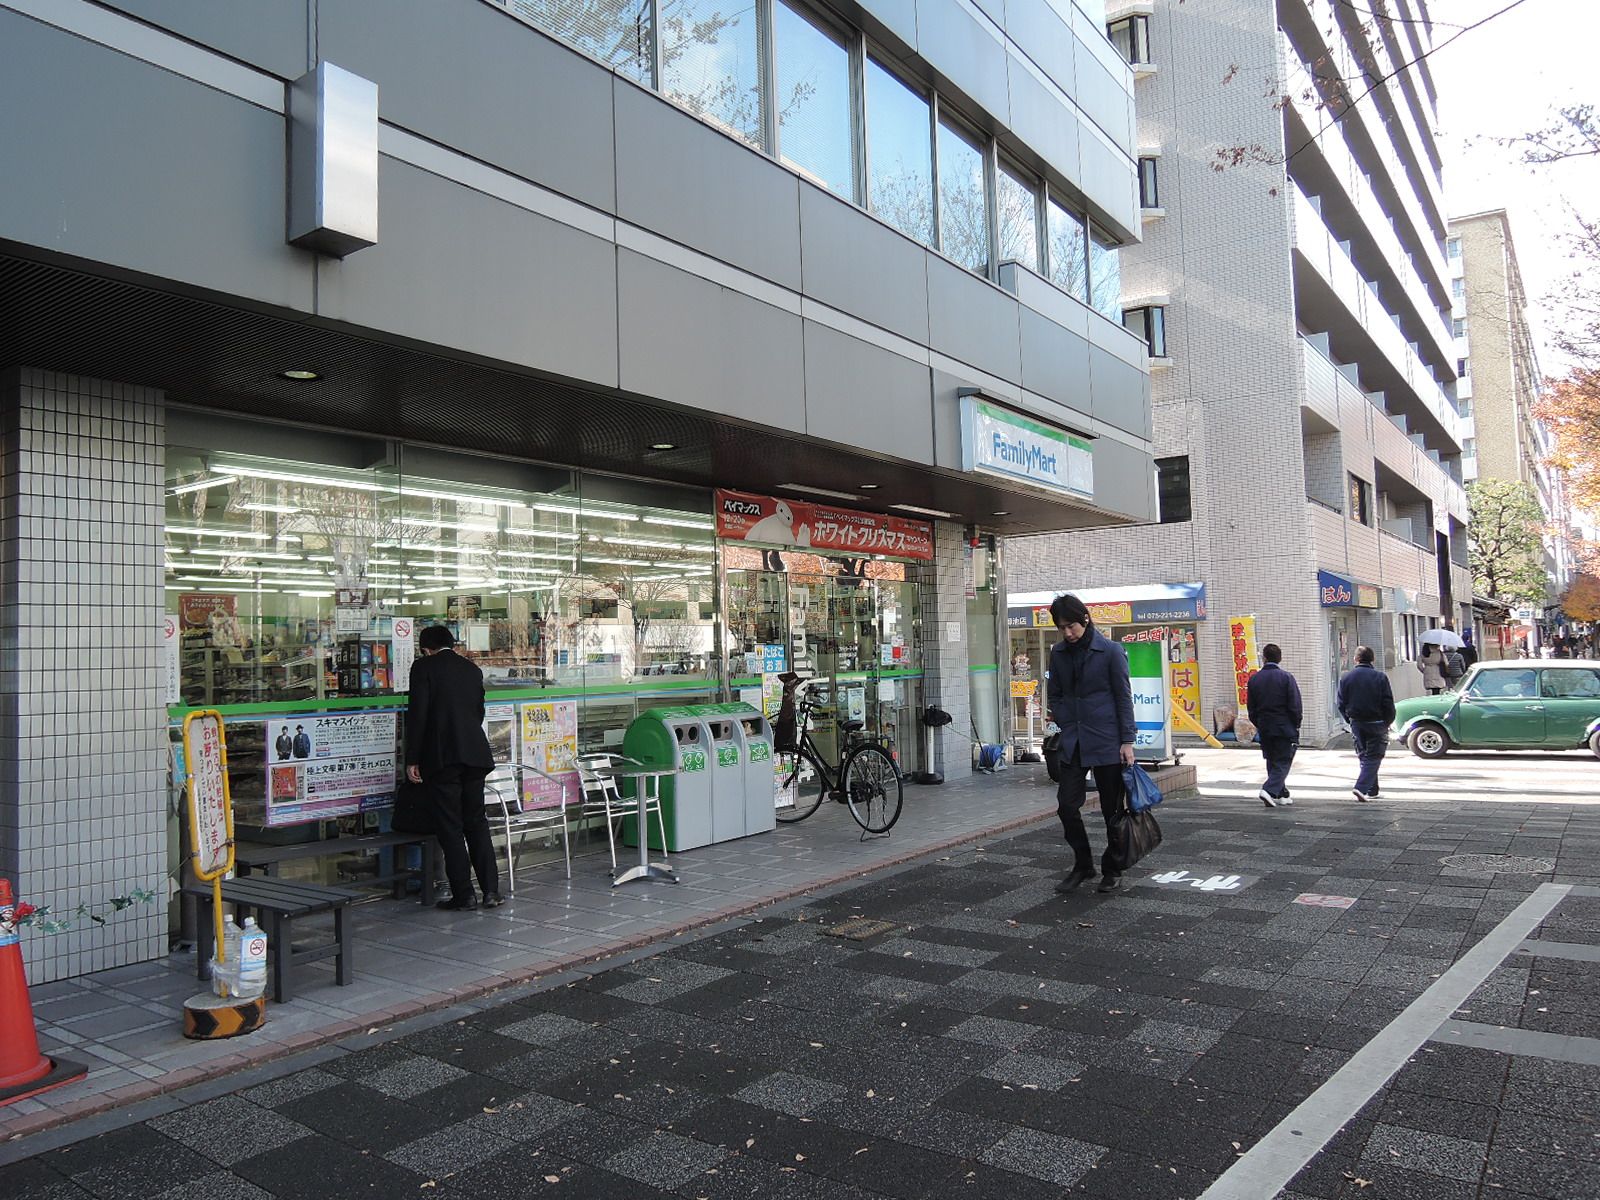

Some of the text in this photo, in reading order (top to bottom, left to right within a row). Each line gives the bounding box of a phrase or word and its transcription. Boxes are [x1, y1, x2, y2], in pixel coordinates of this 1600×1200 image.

[992, 432, 1057, 474] FamilyMart
[813, 520, 905, 551] ホワイトクリスマス
[1321, 585, 1351, 603] はん
[764, 647, 784, 658] たばこ
[316, 716, 368, 728] スキマスイッチ
